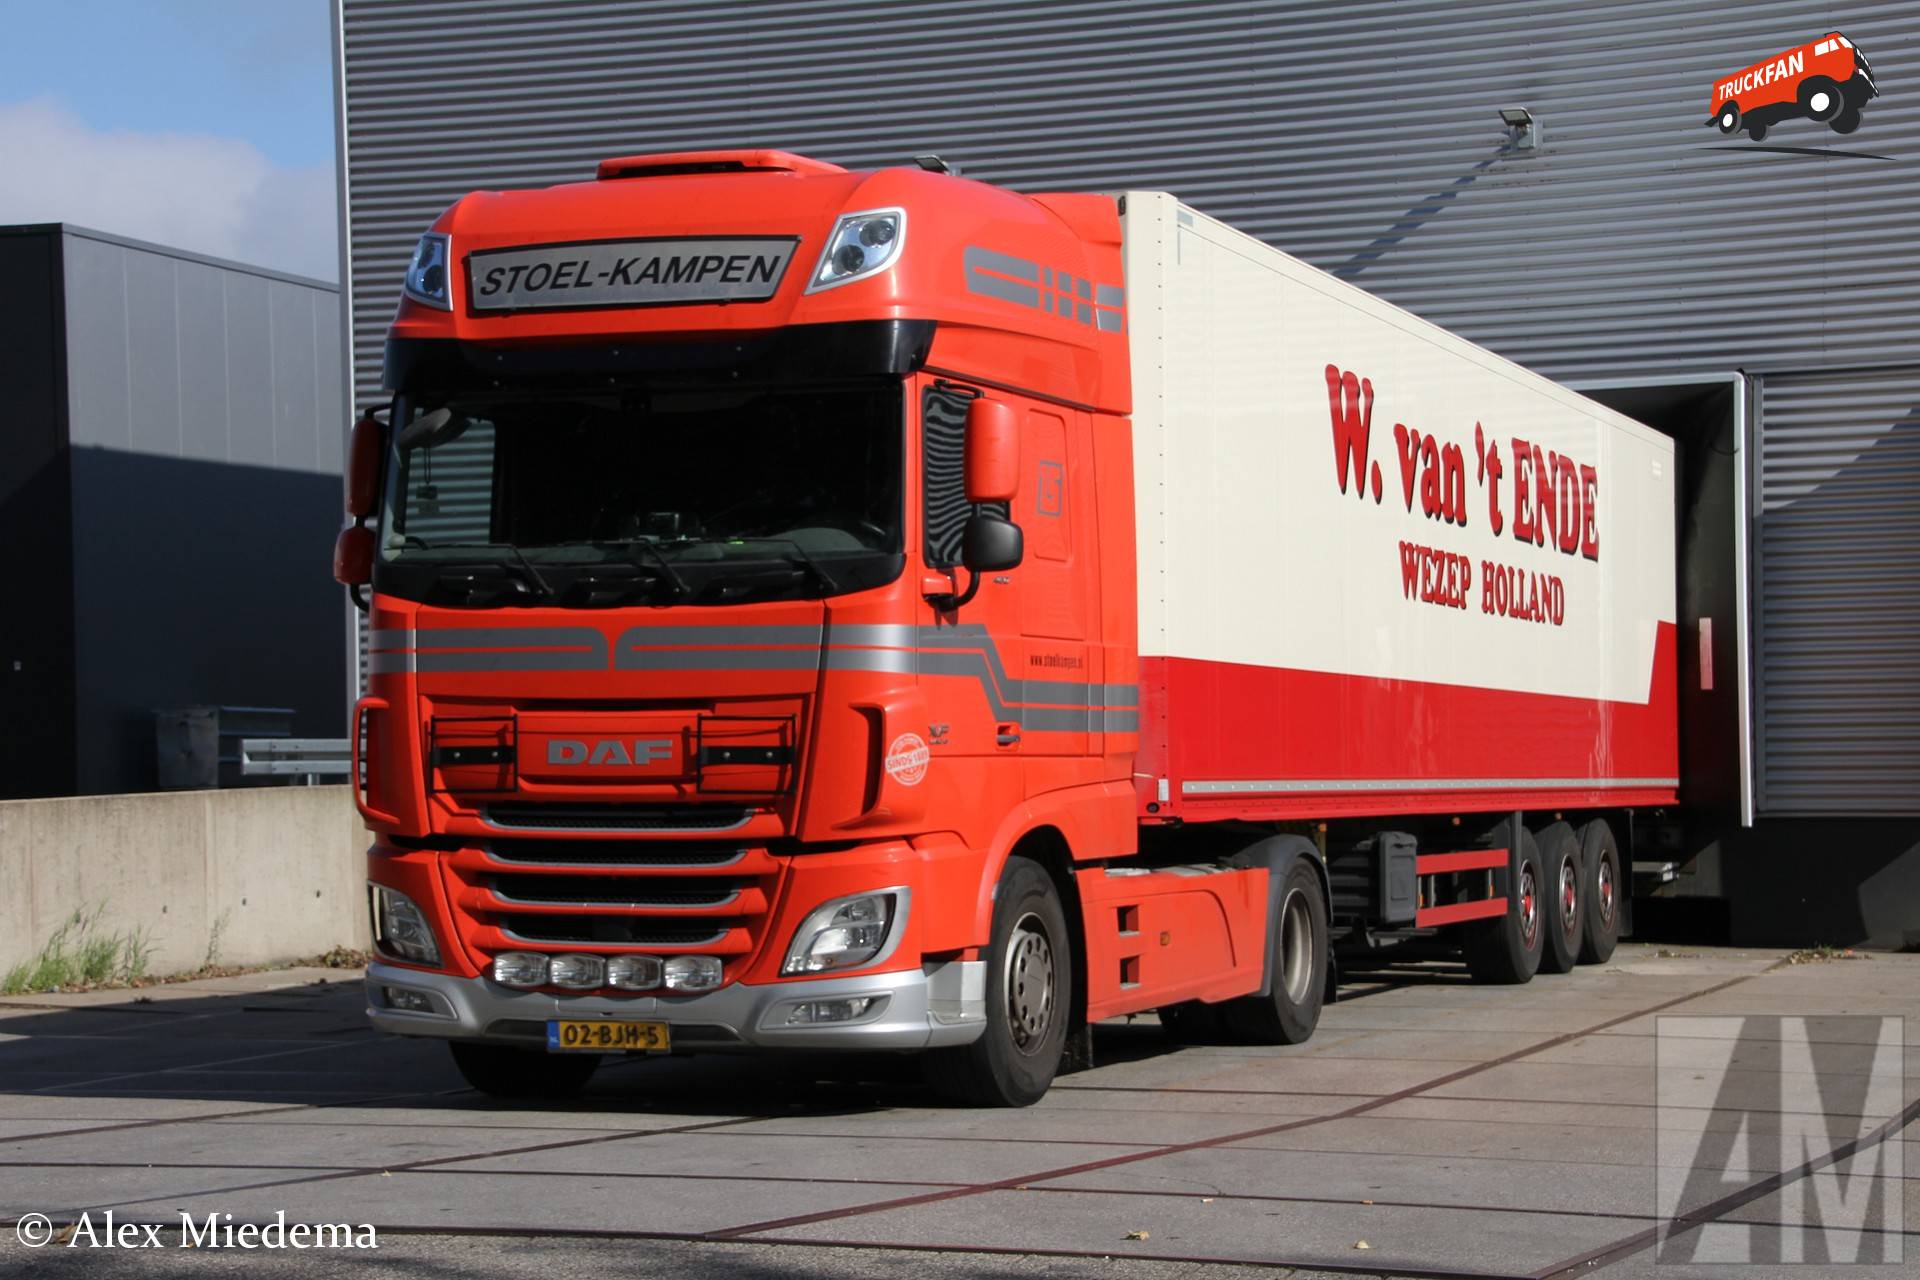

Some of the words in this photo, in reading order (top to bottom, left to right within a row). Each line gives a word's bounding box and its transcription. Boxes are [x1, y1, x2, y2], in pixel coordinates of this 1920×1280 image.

[480, 254, 781, 296] STOEL-KAMPEN
[1325, 364, 1382, 505] W.
[1393, 423, 1467, 527] van
[1474, 421, 1503, 537] 't
[1511, 437, 1599, 563] ENDE
[1399, 540, 1471, 610] WEZEP
[1481, 559, 1565, 626] HOLLAND
[547, 739, 673, 765] DAF
[563, 1024, 659, 1046] 02-BJH-5
